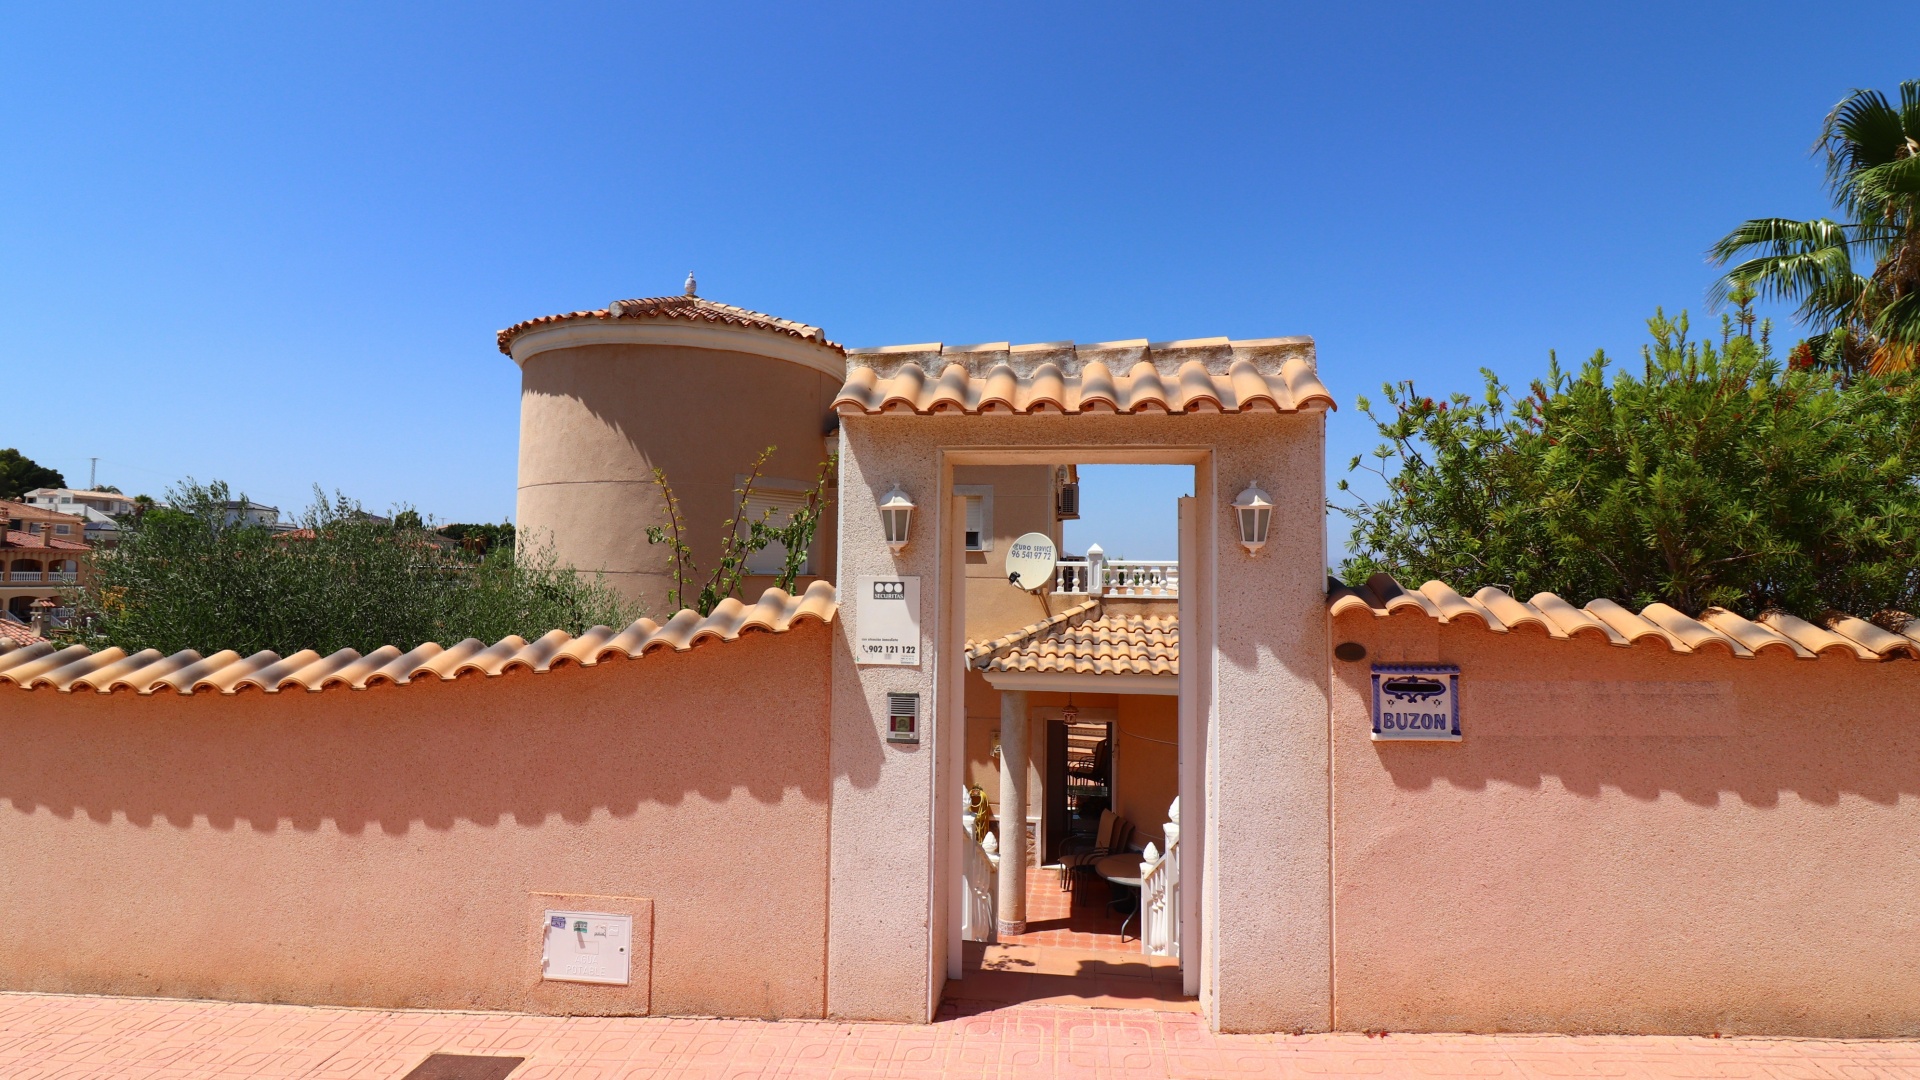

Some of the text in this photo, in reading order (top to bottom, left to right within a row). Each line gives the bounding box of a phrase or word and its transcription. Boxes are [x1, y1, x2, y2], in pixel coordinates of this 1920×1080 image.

[1012, 550, 1020, 558] 96
[1022, 551, 1033, 559] 541
[1043, 552, 1051, 560] 72
[868, 645, 916, 654] 902 121 122
[1383, 712, 1446, 730] BUZON
[576, 954, 598, 964] AGUA
[566, 965, 606, 976] POTABLE
